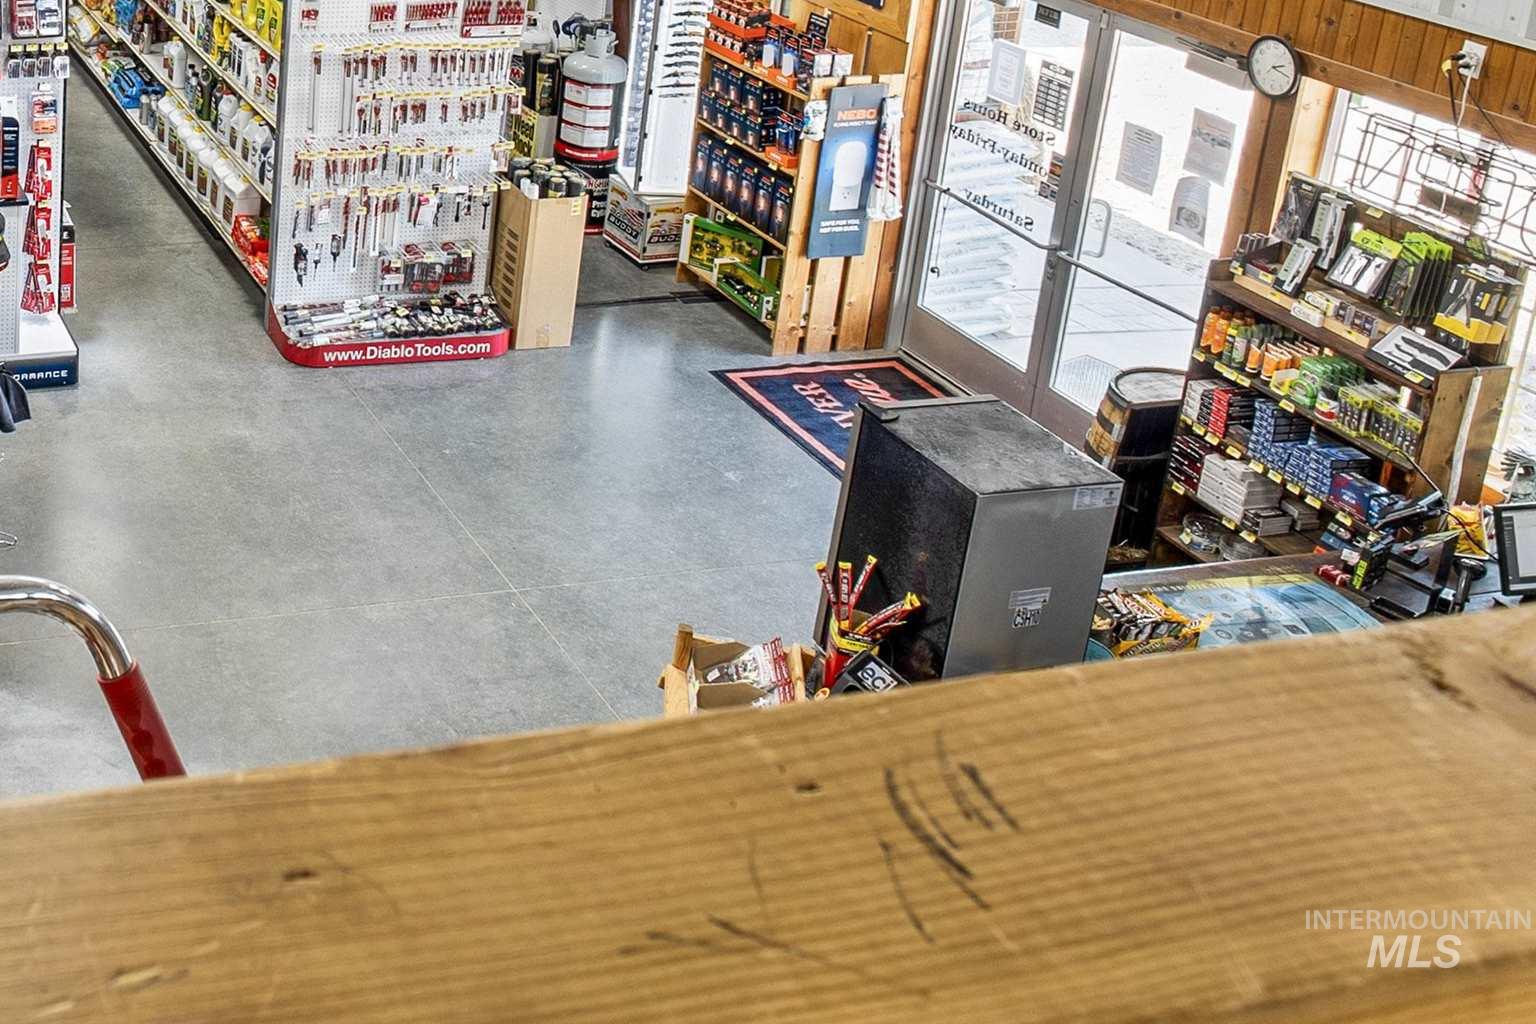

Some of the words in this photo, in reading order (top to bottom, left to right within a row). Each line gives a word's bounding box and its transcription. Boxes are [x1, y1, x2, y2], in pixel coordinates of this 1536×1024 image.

[837, 109, 877, 121] NEBO
[609, 216, 637, 237] BUDDY
[323, 342, 491, 362] www.DiabloTools.com
